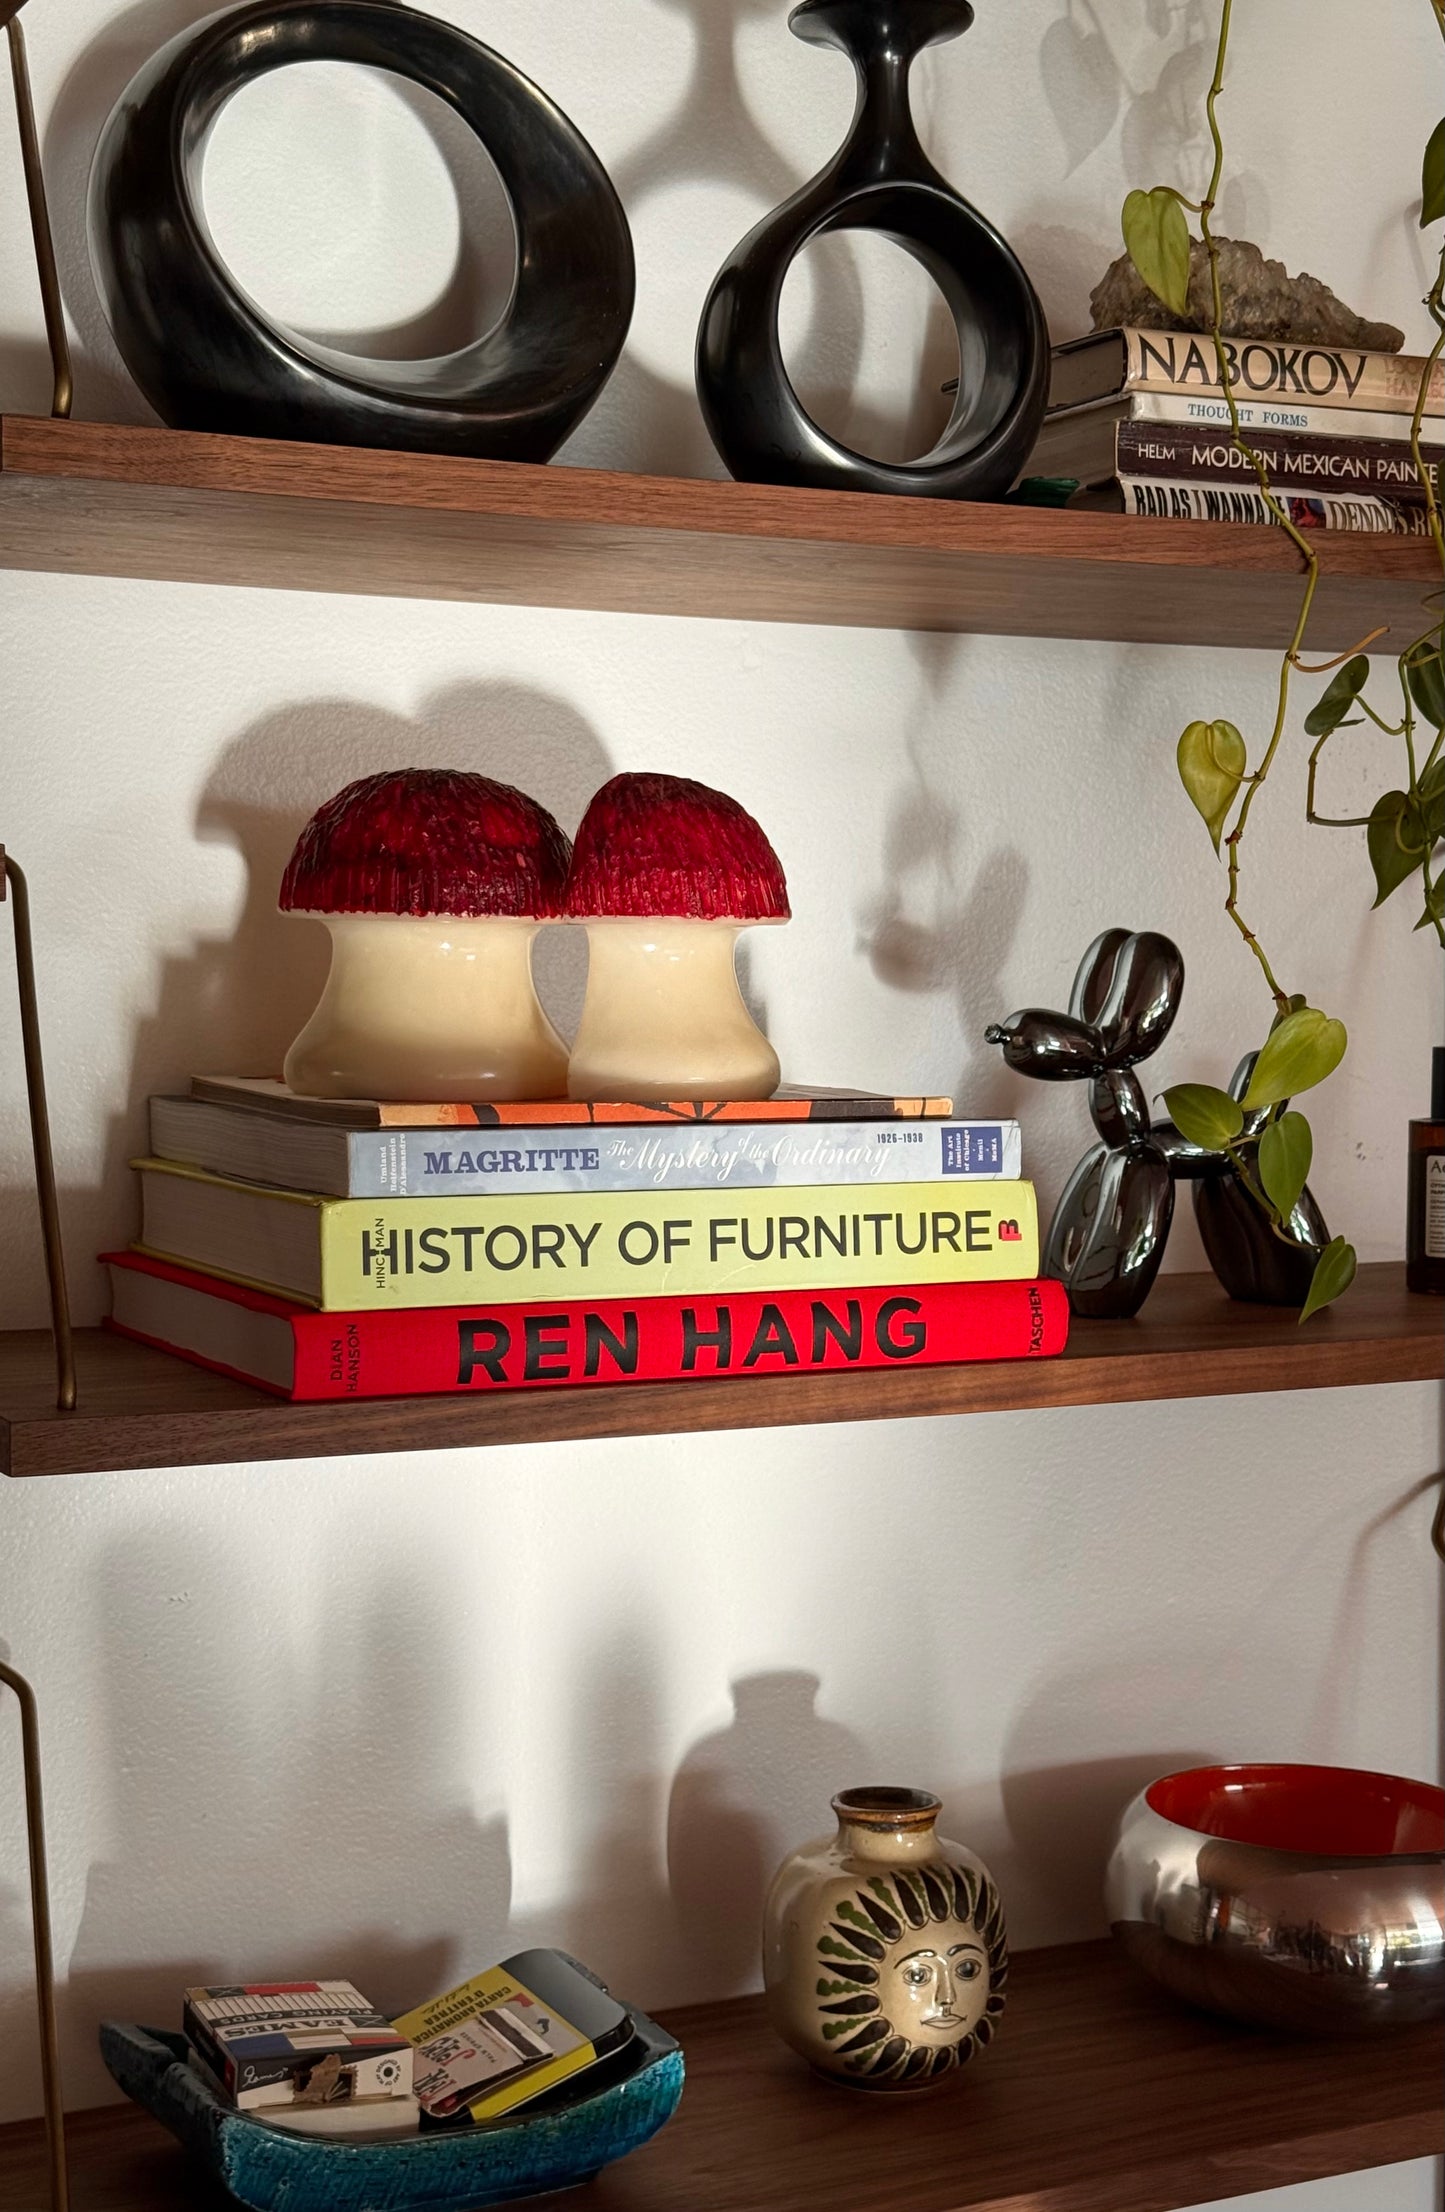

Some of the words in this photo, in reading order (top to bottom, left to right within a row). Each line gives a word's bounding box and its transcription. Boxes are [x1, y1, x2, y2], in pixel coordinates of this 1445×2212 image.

[1138, 333, 1367, 399] NABOKOV
[1263, 411, 1308, 428] FORMS
[1138, 443, 1175, 460] HELM
[1192, 445, 1277, 471] MODERN
[1284, 453, 1369, 479] MEXICAN
[1377, 459, 1438, 484] PAINE
[1133, 485, 1168, 517] BAD
[1170, 487, 1191, 519] AS
[1202, 490, 1265, 525] WANNA
[389, 1137, 397, 1192] Helfenstein
[423, 1147, 600, 1175] MAGRITTE
[606, 1138, 634, 1157] The
[620, 1137, 738, 1183] Mystery
[738, 1131, 754, 1154] of
[750, 1142, 770, 1161] the
[771, 1134, 892, 1178] Ordinary
[362, 1222, 603, 1276] HISTORY
[618, 1220, 692, 1266] OF
[709, 1210, 993, 1262] FURNITURE
[457, 1311, 640, 1385] REN
[680, 1296, 928, 1371] HANG
[1027, 1287, 1042, 1356] TASCHEN
[330, 1339, 343, 1381] DIAN
[346, 1324, 359, 1393] HANSON
[291, 2008, 373, 2017] PLAYING
[424, 1989, 485, 2026] D'ERITREA
[475, 1986, 512, 2009] CARTA
[217, 2012, 282, 2025] CARDS
[224, 2018, 349, 2039] EAMES
[411, 2006, 476, 2044] AROMATICA
